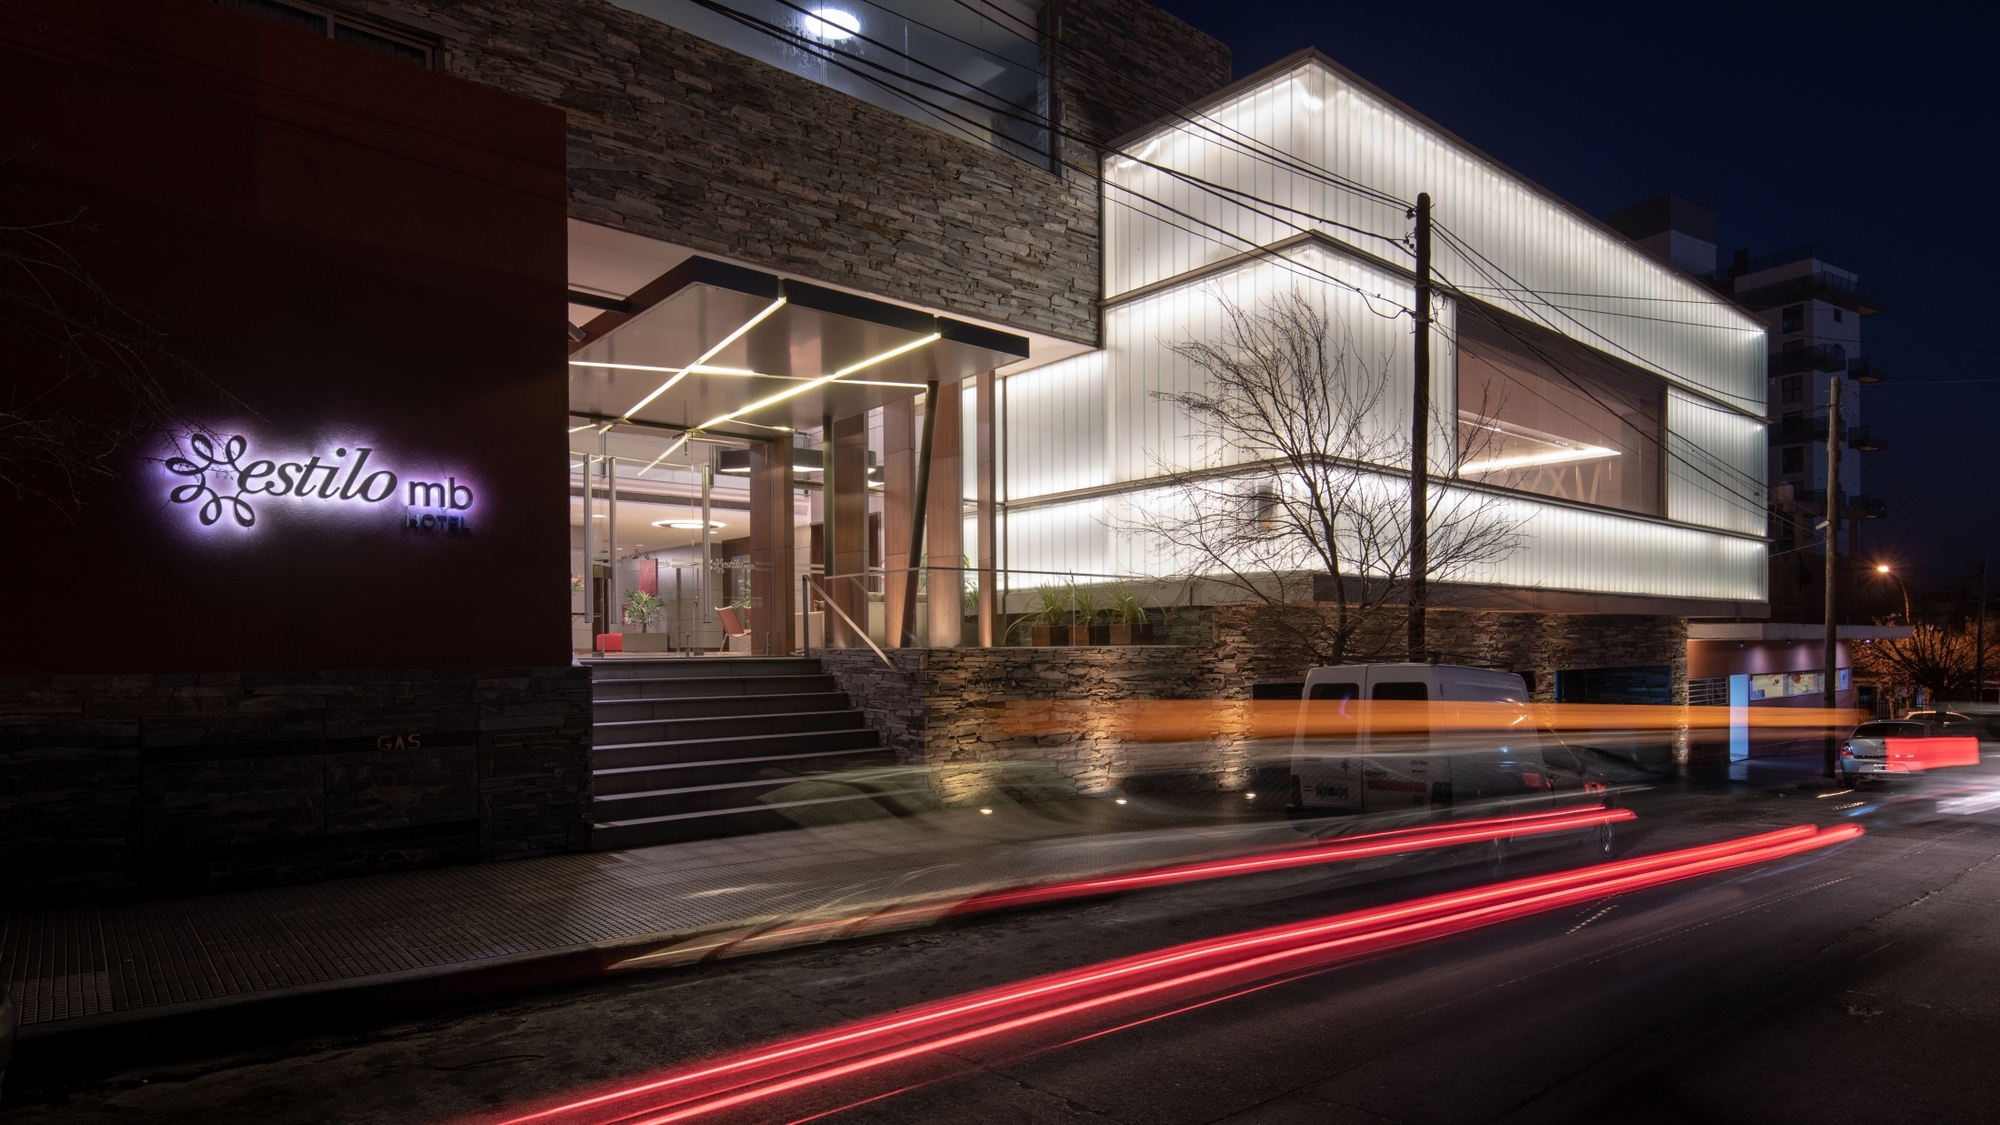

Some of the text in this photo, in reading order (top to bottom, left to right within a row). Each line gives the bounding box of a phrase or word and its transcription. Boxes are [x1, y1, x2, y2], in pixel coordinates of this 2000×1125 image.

[238, 447, 474, 510] estilo mb
[405, 513, 471, 531] HOTEL
[377, 733, 421, 751] GAS
